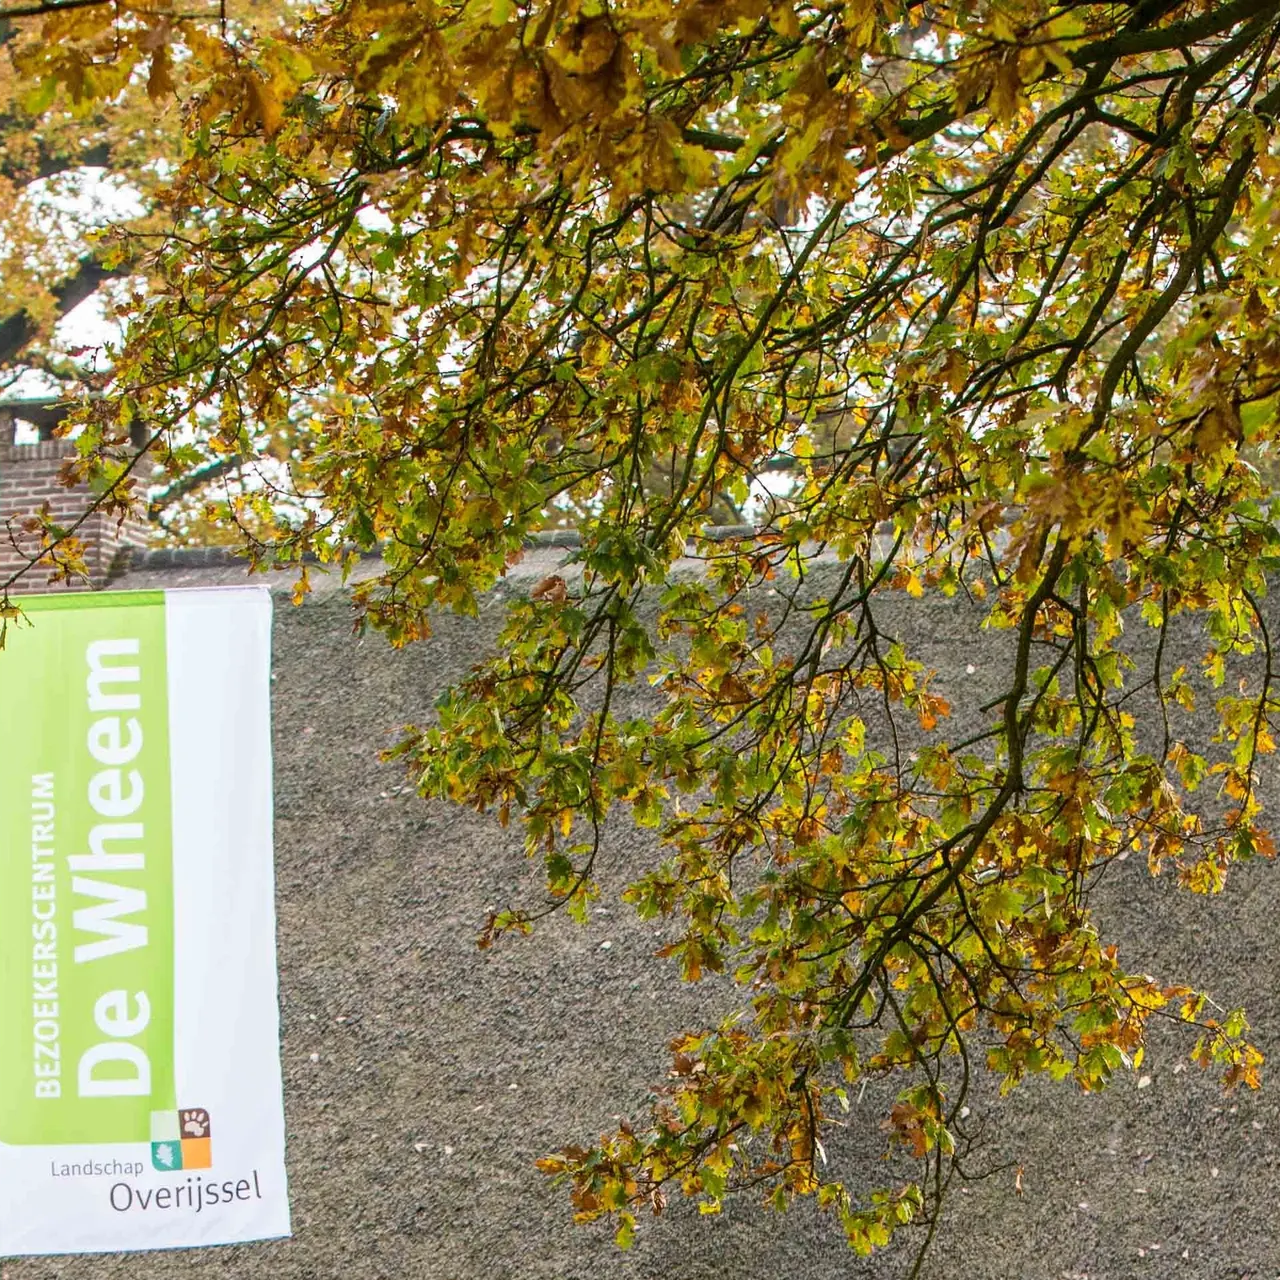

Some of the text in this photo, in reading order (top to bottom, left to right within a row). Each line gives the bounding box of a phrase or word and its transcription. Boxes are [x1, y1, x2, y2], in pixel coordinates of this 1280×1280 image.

[33, 772, 61, 1099] BEZOEKERSCENTRUM
[67, 636, 152, 1098] De Wheem
[51, 1158, 145, 1177] Landschap
[109, 1170, 263, 1213] Overijssel
